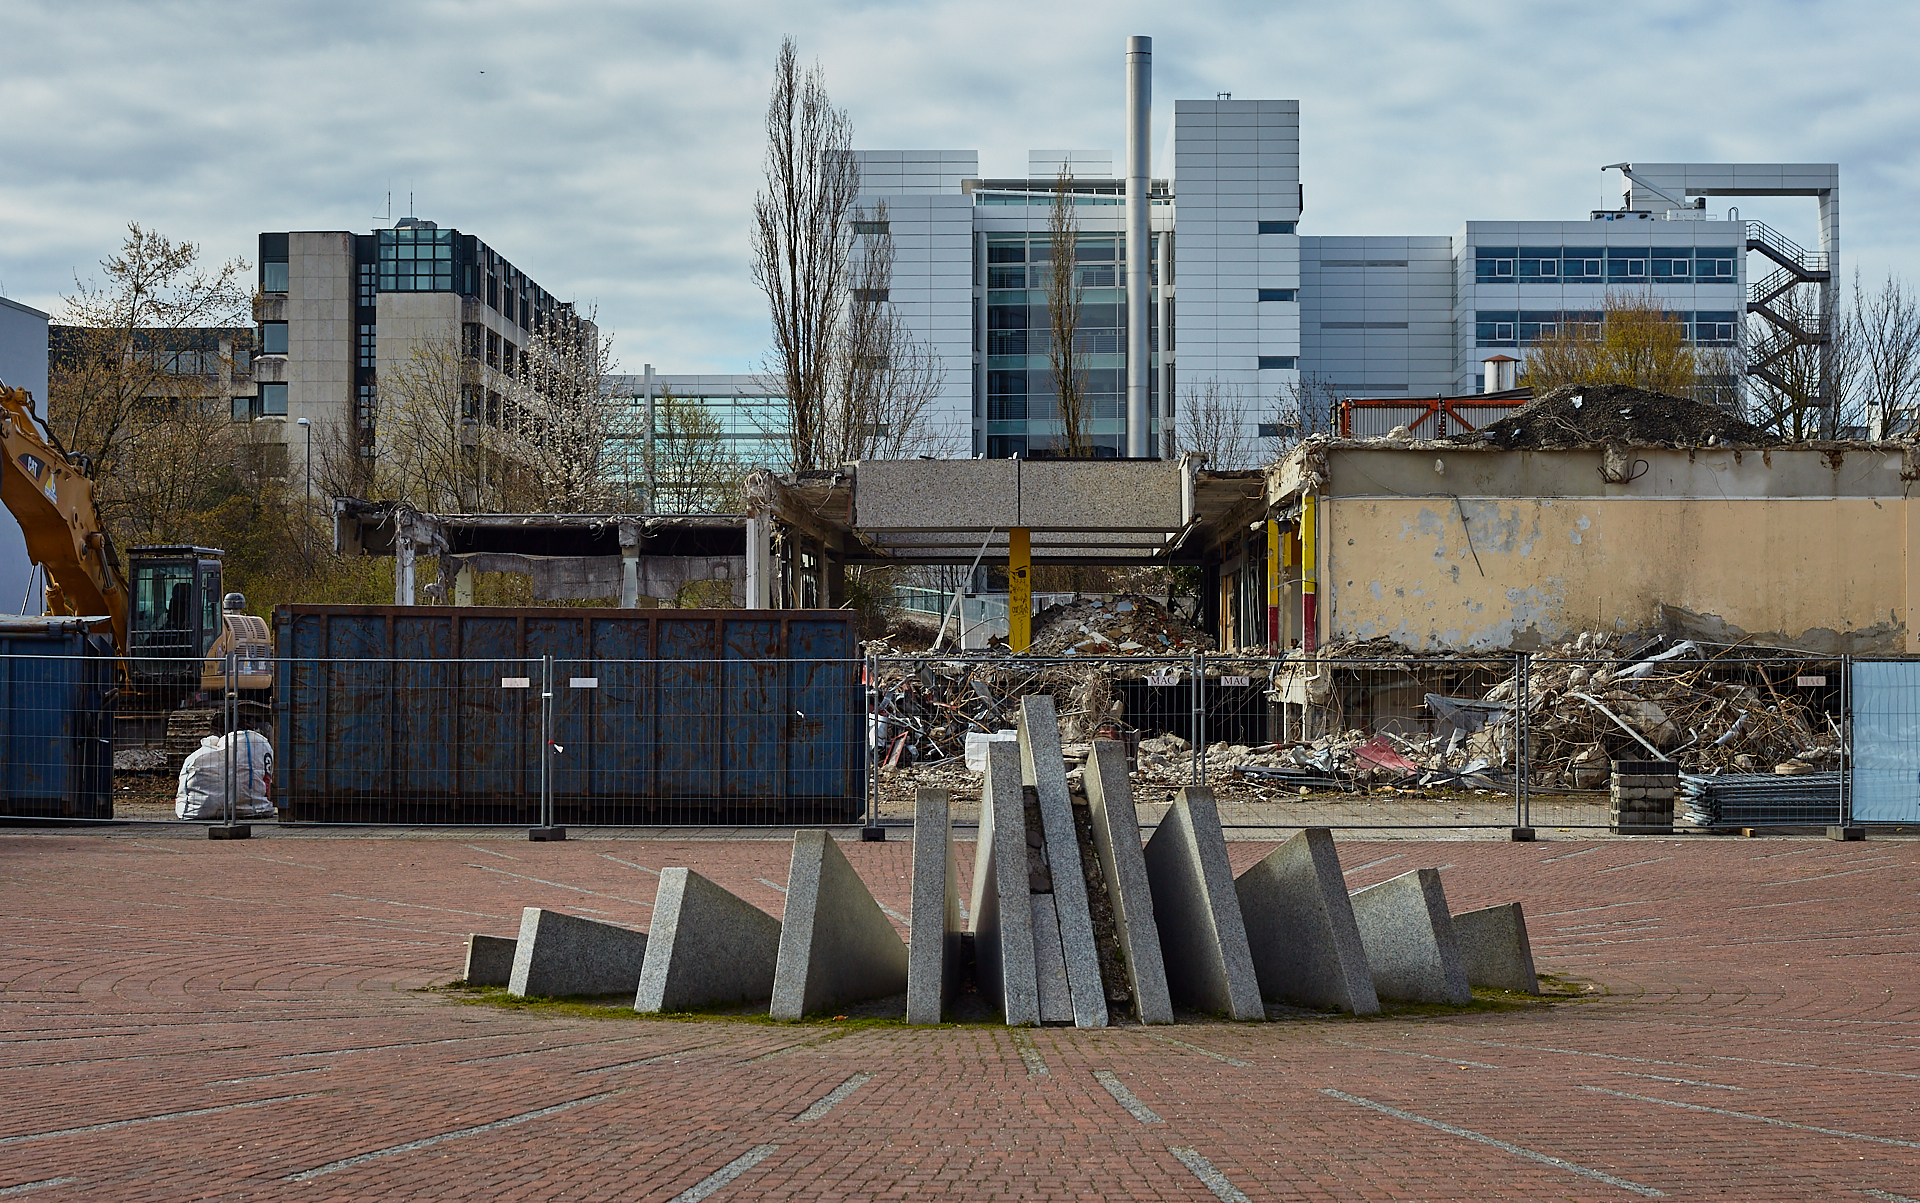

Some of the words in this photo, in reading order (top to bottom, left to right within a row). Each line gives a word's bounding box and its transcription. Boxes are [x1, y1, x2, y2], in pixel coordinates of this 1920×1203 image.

[27, 456, 38, 478] CAT
[1151, 676, 1174, 685] MAC
[1224, 676, 1247, 685] MAC
[1799, 677, 1824, 686] MAC
